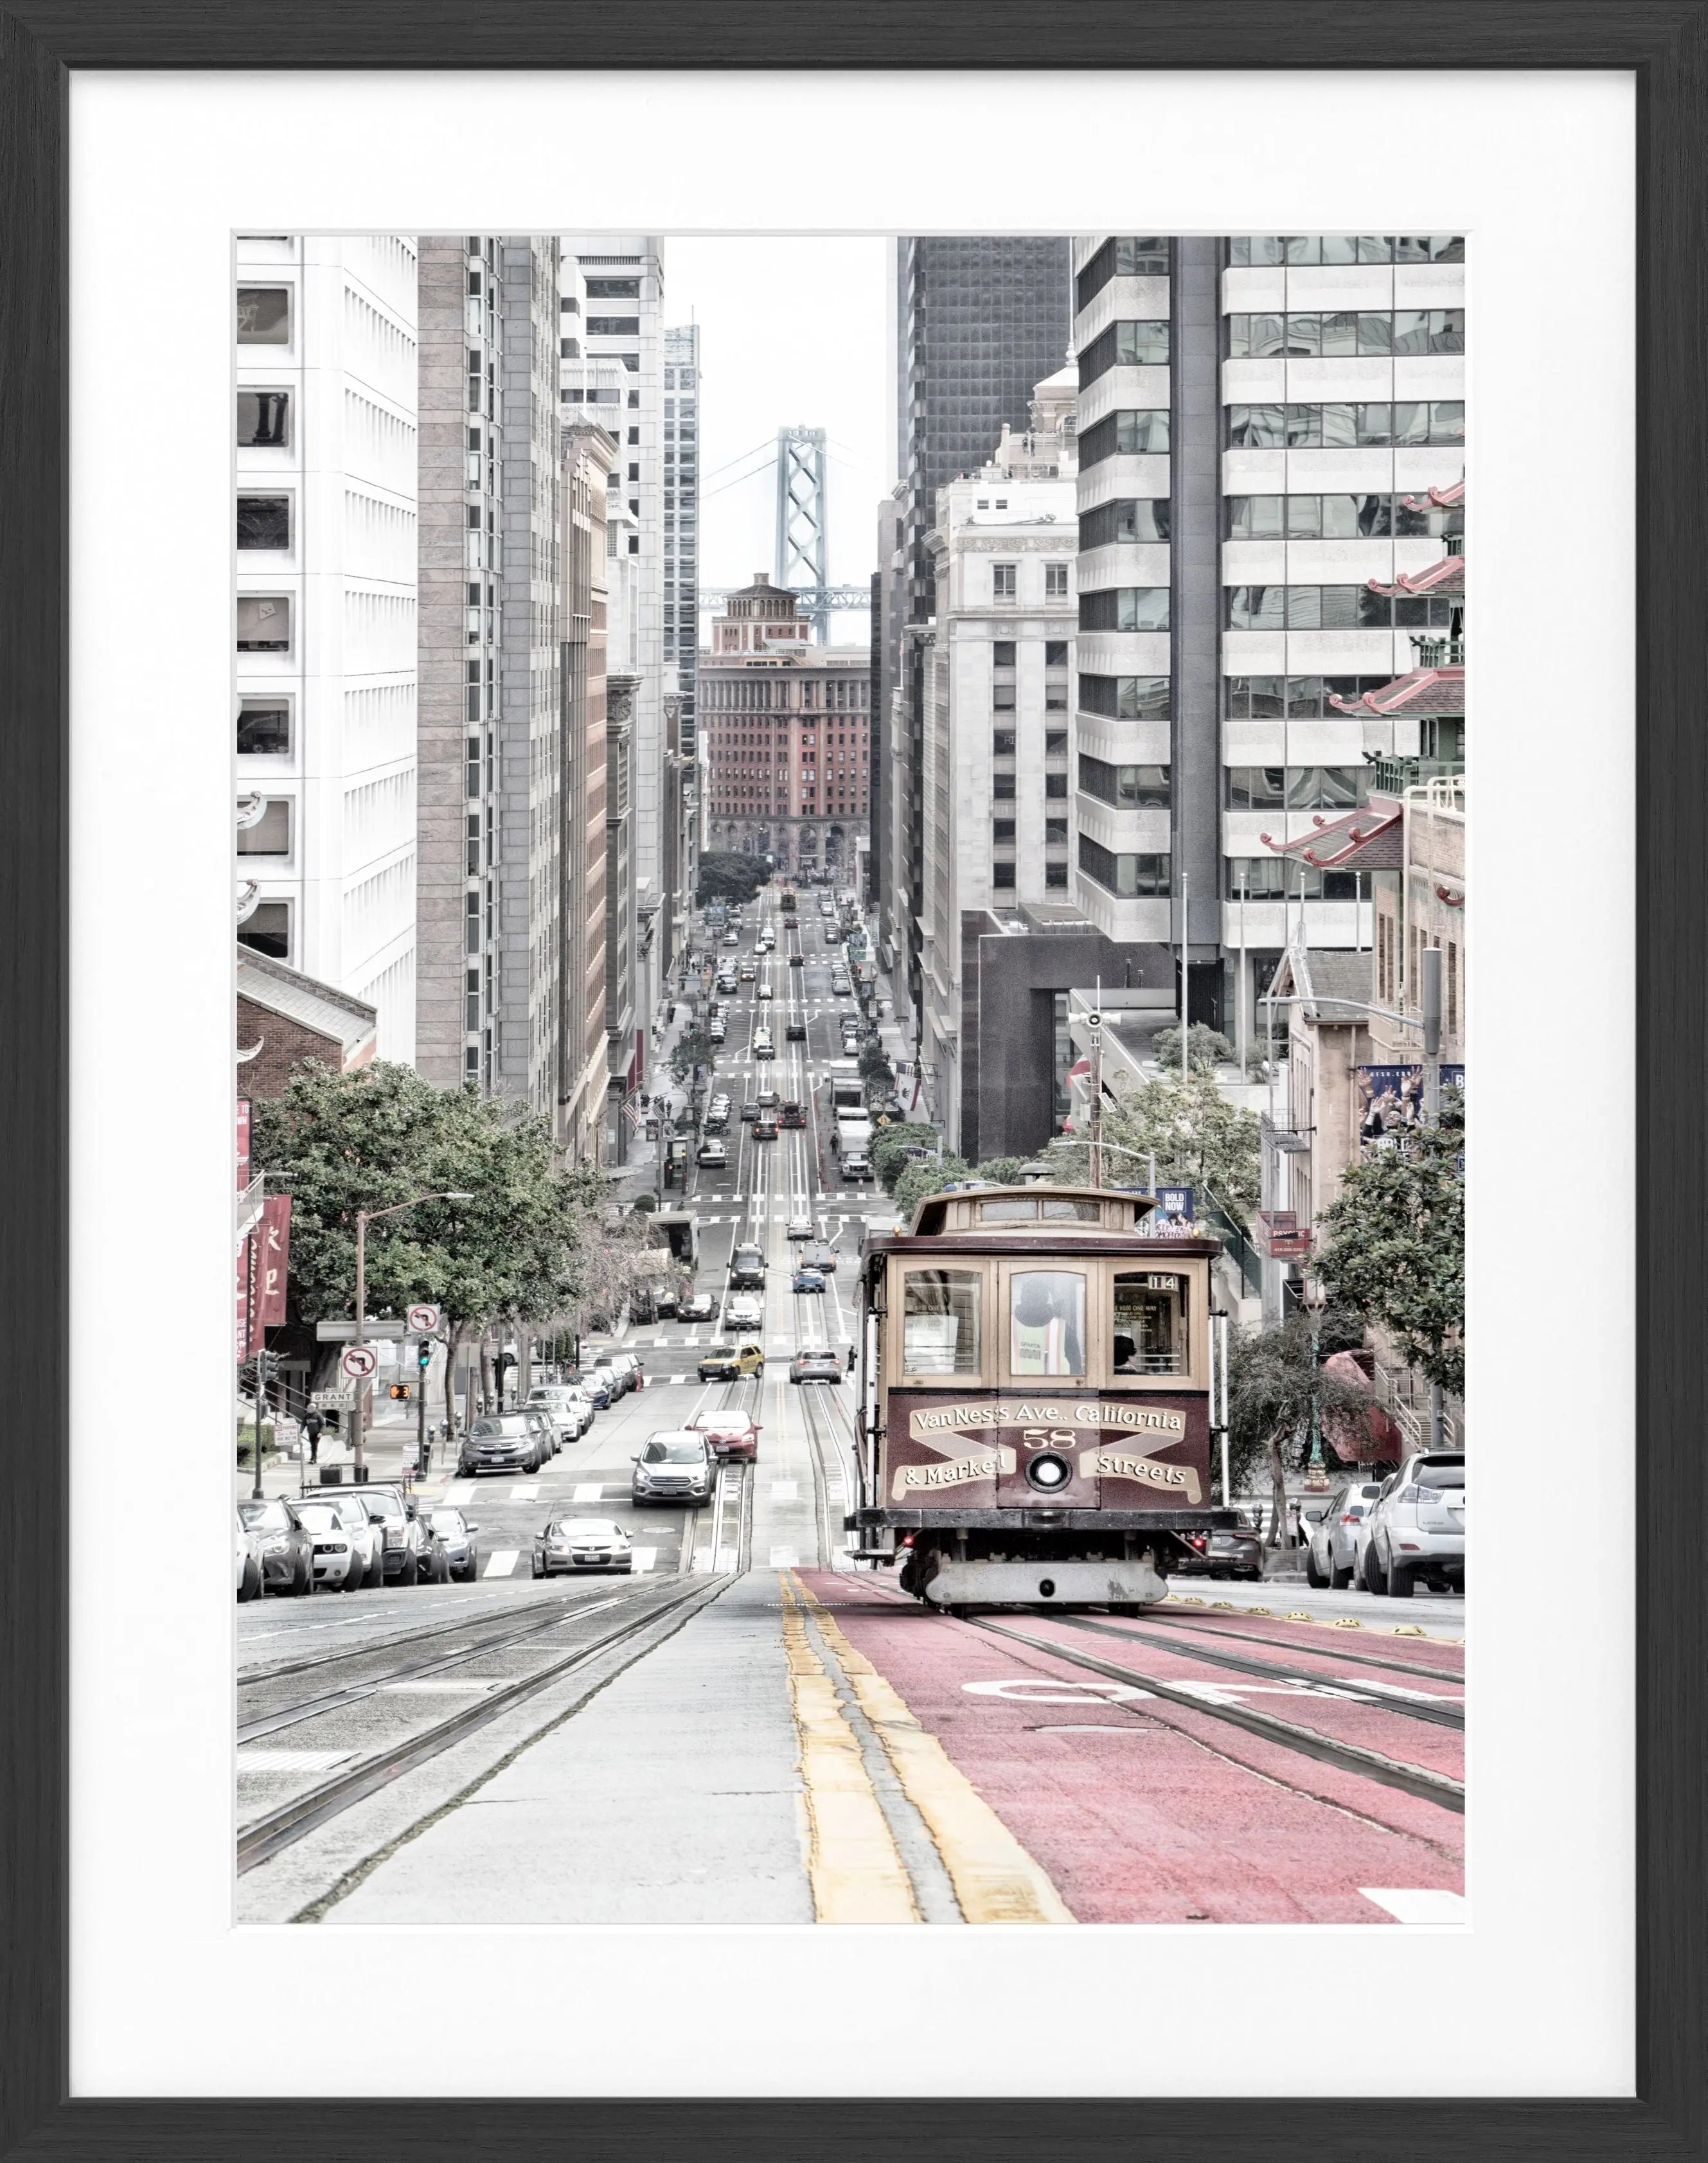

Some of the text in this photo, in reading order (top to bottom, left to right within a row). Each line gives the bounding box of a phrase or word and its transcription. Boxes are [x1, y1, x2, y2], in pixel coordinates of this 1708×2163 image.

[241, 1105, 249, 1114] TO
[1164, 1193, 1184, 1202] BOLD
[1164, 1202, 1184, 1211] NOW
[1152, 1276, 1175, 1290] 14
[915, 1412, 952, 1429] Van
[954, 1407, 1009, 1425] Ness
[1075, 1405, 1182, 1430] California
[1023, 1429, 1076, 1449] 58
[905, 1452, 1187, 1484] & Market Streets
